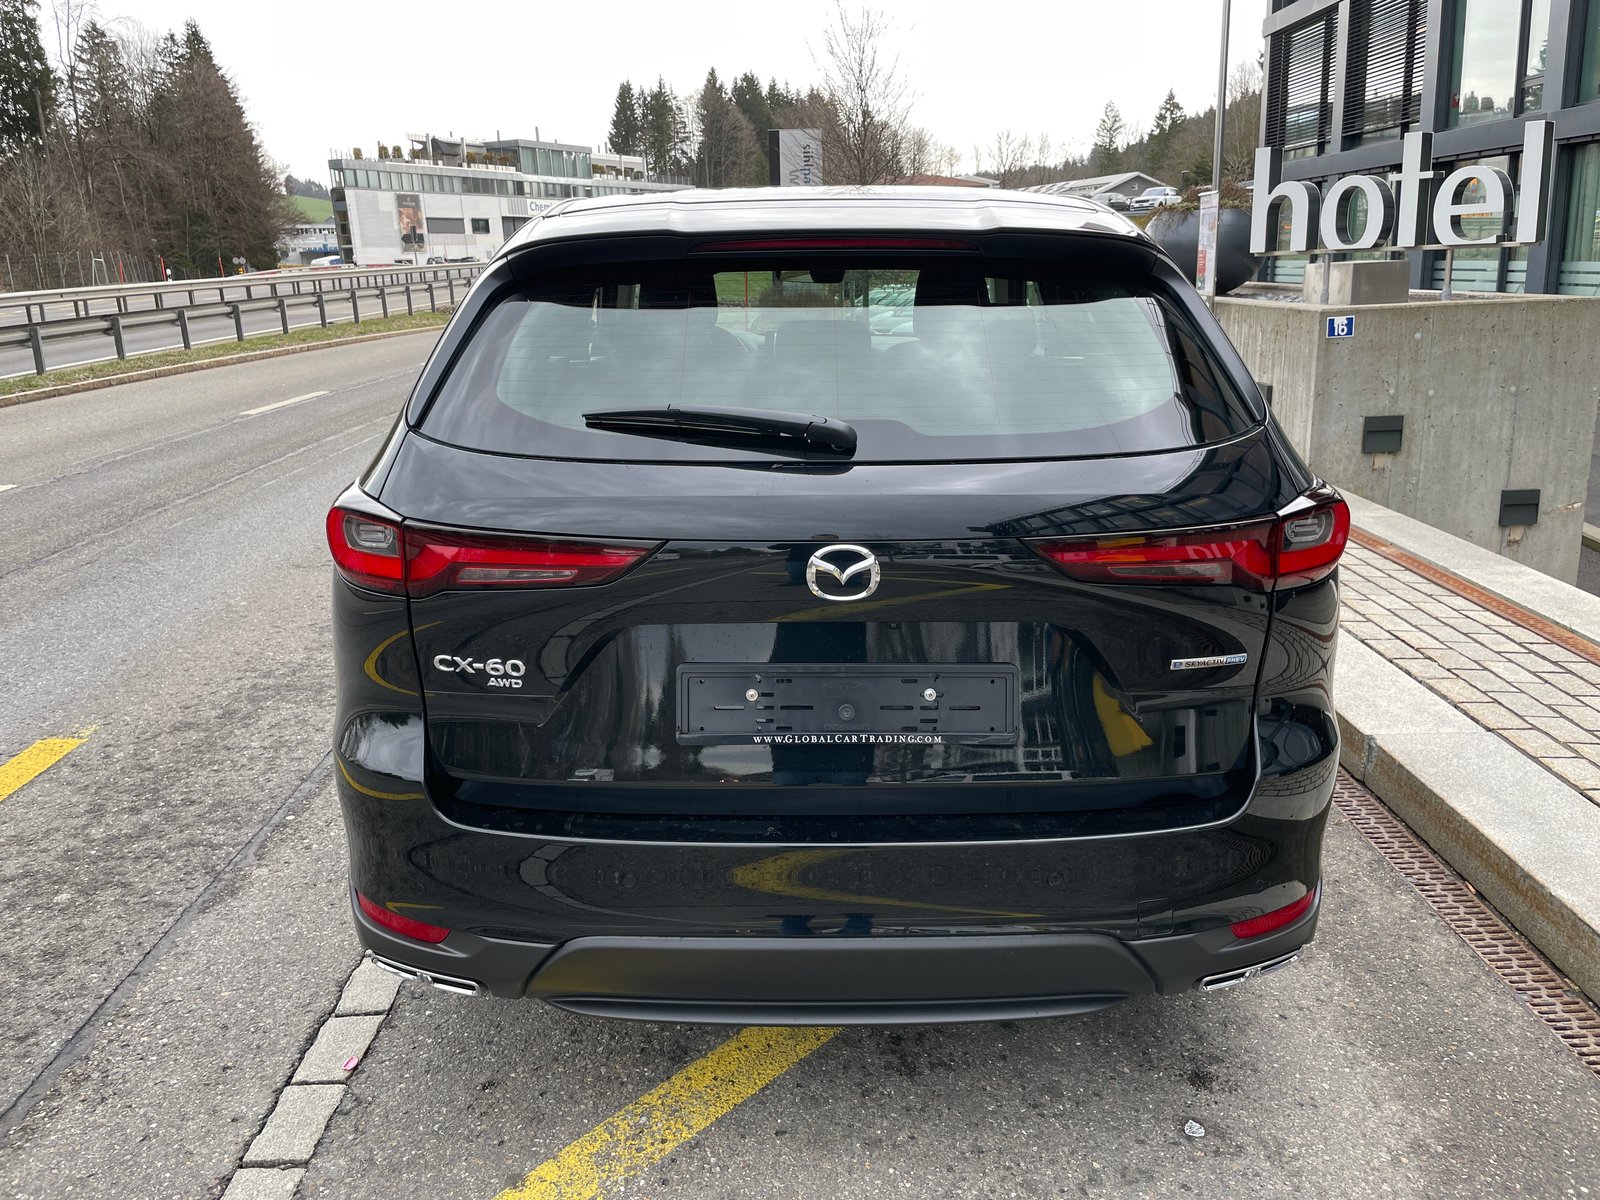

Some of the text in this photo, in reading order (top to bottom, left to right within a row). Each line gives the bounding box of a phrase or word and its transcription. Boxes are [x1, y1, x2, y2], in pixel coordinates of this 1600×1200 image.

[1250, 120, 1554, 253] hotel
[1333, 318, 1348, 336] 16
[433, 654, 527, 677] CX-60
[1185, 659, 1225, 668] SKYACTIV
[1225, 655, 1246, 664] PHEV
[486, 677, 524, 688] AWD
[752, 734, 943, 744] WWW.GLOBALCARTRADING.COM
